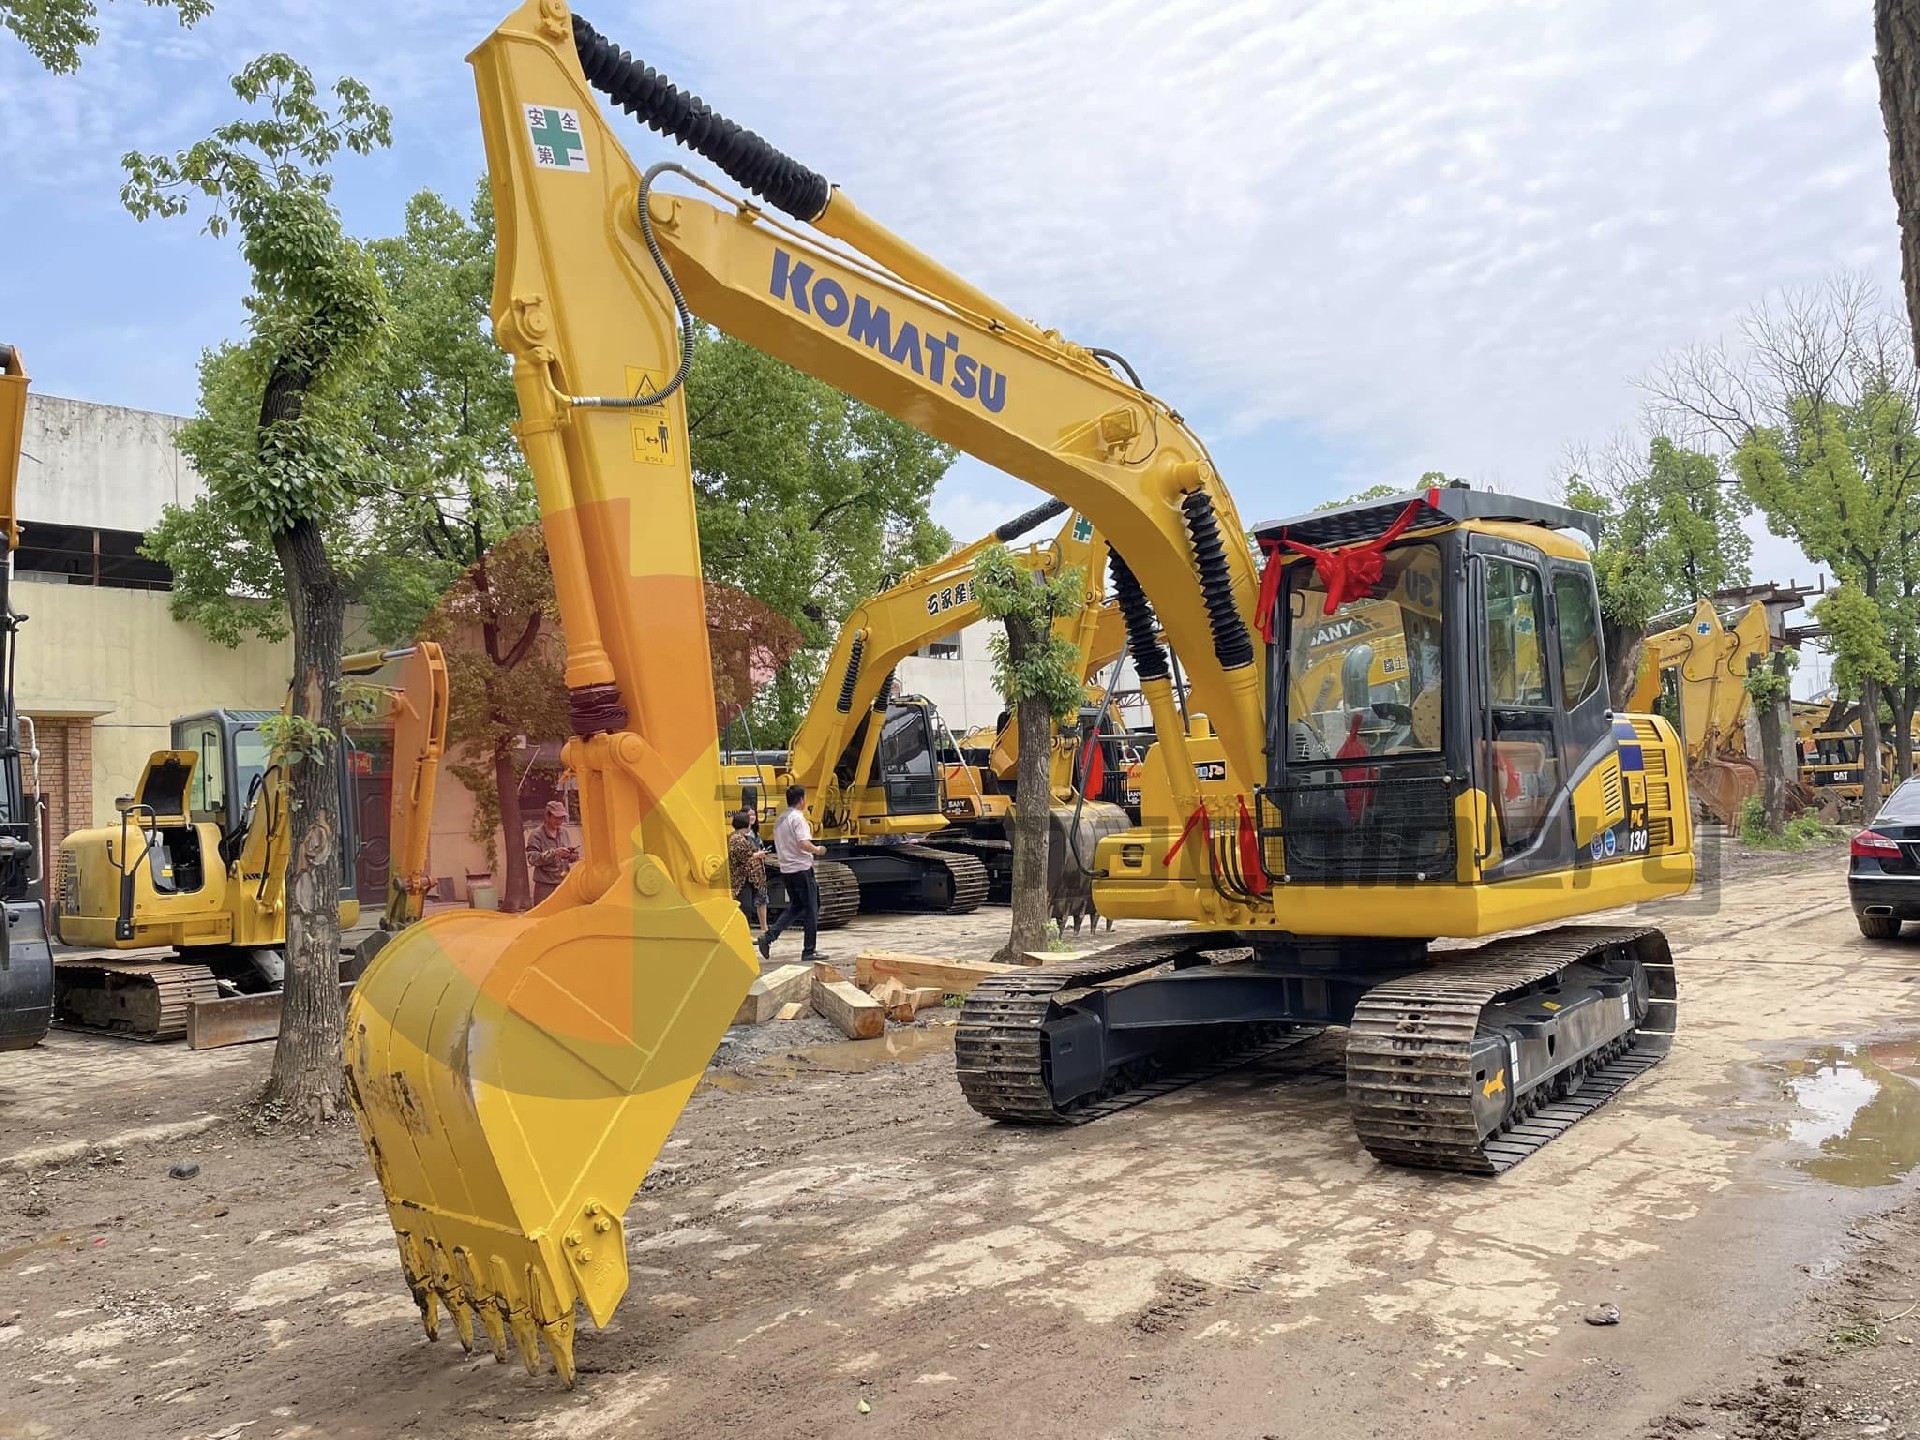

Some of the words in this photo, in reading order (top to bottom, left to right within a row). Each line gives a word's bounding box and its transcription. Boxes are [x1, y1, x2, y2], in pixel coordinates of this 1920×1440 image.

[769, 247, 1007, 413] KOMATSU
[1833, 771, 1848, 781] CAT
[1630, 808, 1644, 829] PC
[1629, 829, 1648, 853] 130
